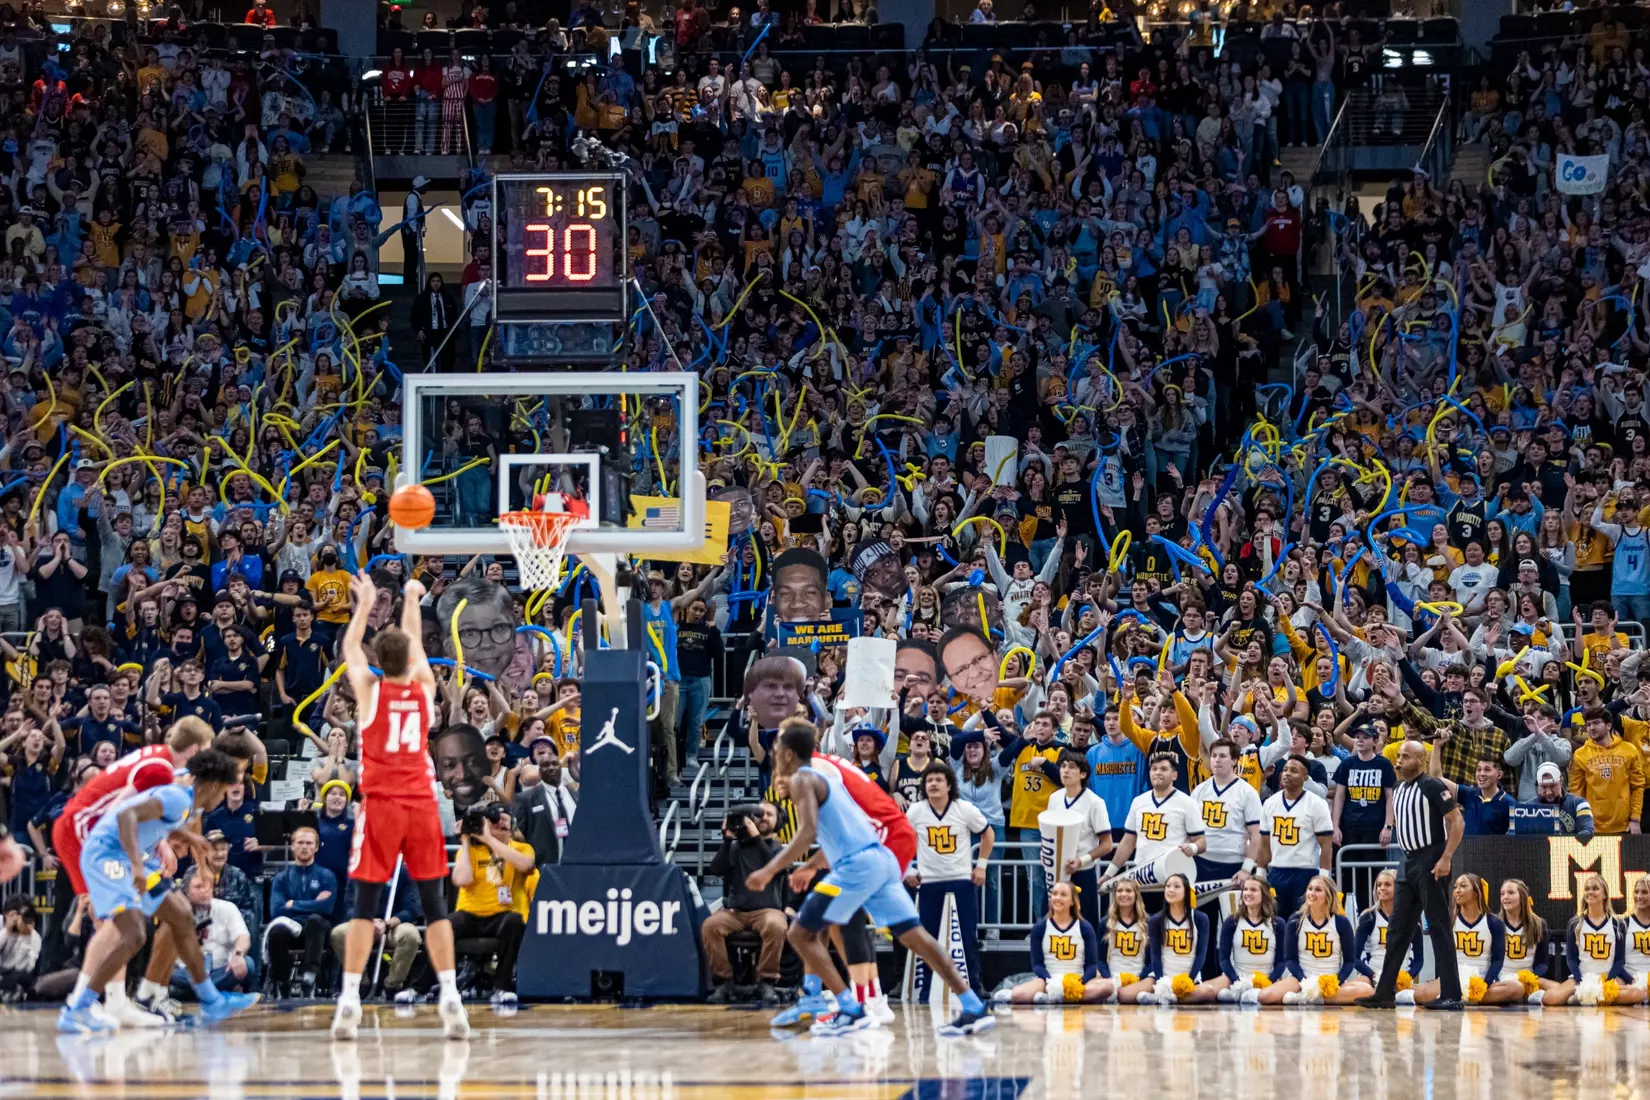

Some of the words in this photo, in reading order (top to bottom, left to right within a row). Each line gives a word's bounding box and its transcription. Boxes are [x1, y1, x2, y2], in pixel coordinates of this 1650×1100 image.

[536, 187, 607, 219] 7:15
[525, 224, 597, 282] 30
[1462, 524, 1474, 538] 3
[1147, 556, 1155, 573] 0
[1627, 555, 1638, 571] 4
[795, 625, 815, 635] WE
[817, 623, 843, 633] ARE
[385, 712, 421, 753] 14
[1095, 761, 1136, 775] MARQUETTE
[1348, 768, 1382, 786] BETTER
[1023, 776, 1043, 792] 33
[1141, 812, 1168, 841] MU
[1202, 801, 1228, 829] MU
[927, 826, 957, 854] MU
[1273, 816, 1300, 845] MU
[536, 888, 681, 946] meijer
[1050, 936, 1077, 961] MU
[1115, 931, 1141, 956] MU
[1166, 929, 1193, 954] MU
[1242, 930, 1269, 954] MU
[1305, 932, 1333, 958] MU
[1455, 932, 1484, 957] MU
[1504, 934, 1527, 959] MU
[1584, 934, 1611, 959] MU
